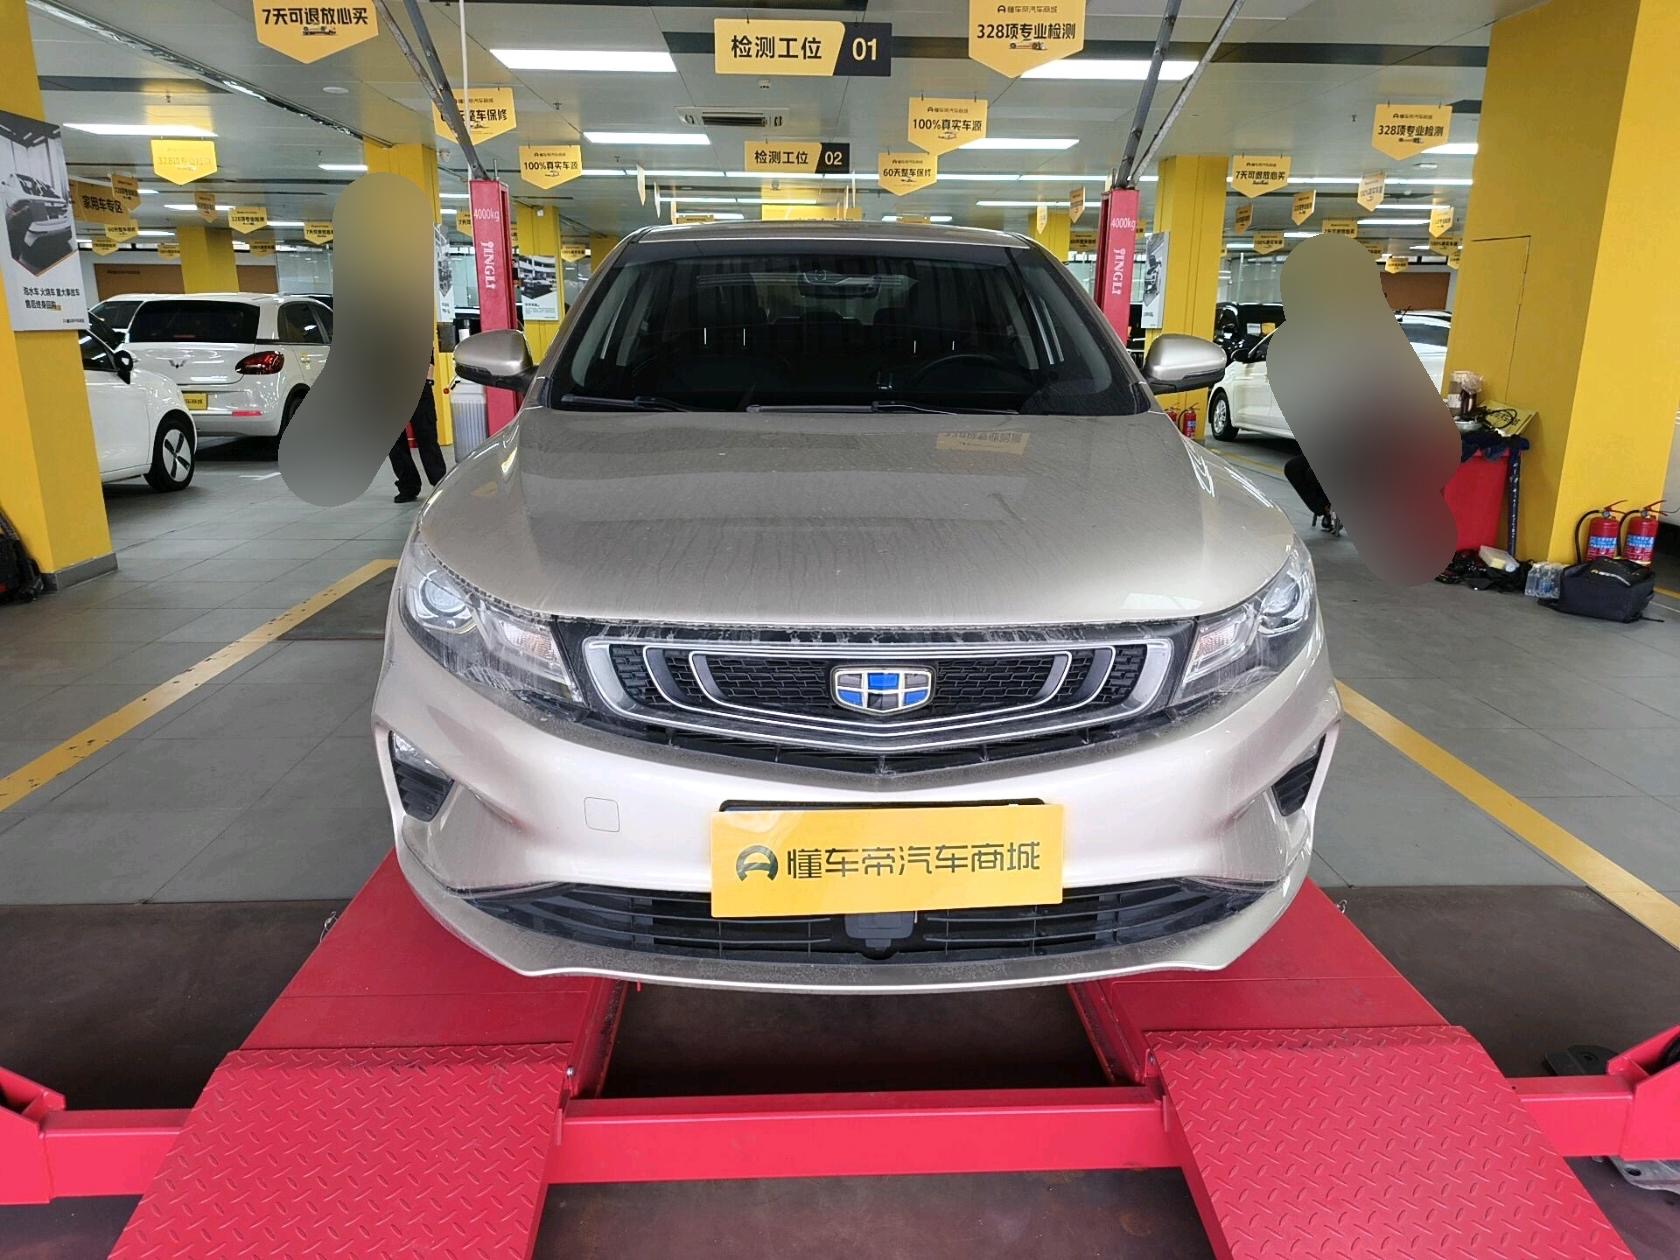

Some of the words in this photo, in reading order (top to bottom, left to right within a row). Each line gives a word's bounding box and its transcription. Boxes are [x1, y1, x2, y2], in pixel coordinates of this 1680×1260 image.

[262, 7, 369, 25] 7天可退放心买
[977, 23, 1076, 39] 328项专业检测
[731, 35, 822, 60] 检测工位
[852, 37, 878, 61] 01
[913, 118, 982, 131] 100%真实车源
[1378, 125, 1444, 137] 328项专业检测
[754, 150, 808, 164] 检测工位
[824, 152, 842, 165] 02
[473, 207, 500, 222] 4000kg
[1111, 217, 1136, 231] 4000kg
[786, 841, 1041, 880] 懂车帝汽车商城
